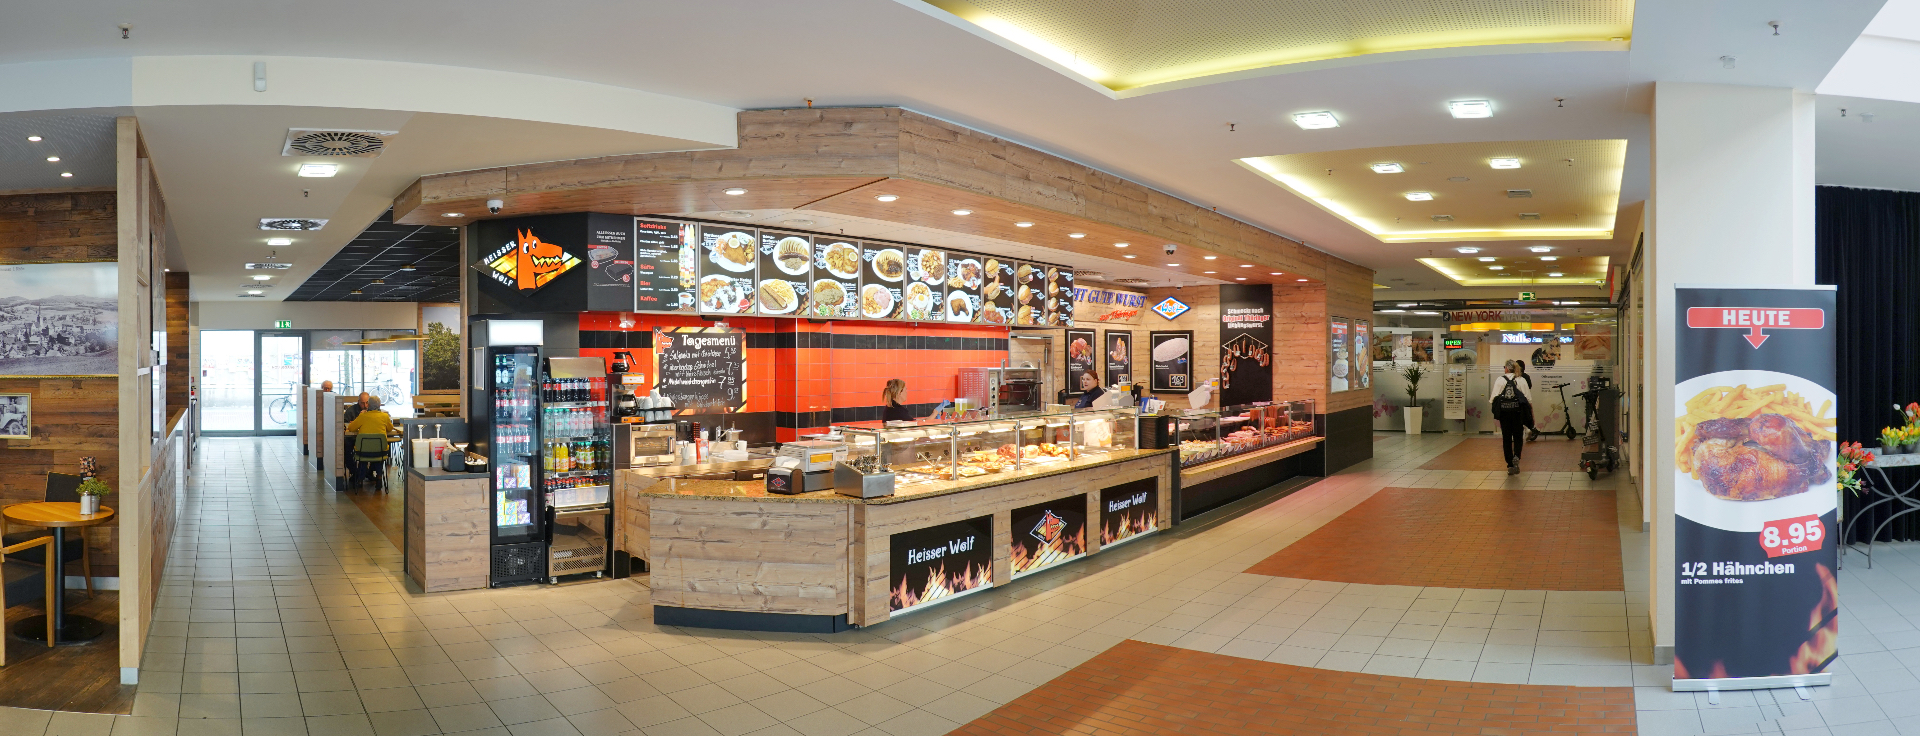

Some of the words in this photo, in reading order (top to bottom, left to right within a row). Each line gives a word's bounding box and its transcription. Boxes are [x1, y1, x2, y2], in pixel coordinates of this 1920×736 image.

[484, 240, 516, 265] HEISSER
[492, 271, 514, 286] WOLF
[1074, 288, 1088, 301] HT
[1088, 290, 1115, 304] GUTE
[1116, 293, 1147, 308] WURST
[1162, 303, 1183, 313] Wolf
[1244, 314, 1270, 322] Thüringer
[1451, 311, 1473, 321] NEW
[1476, 311, 1502, 321] YORK
[1504, 311, 1531, 321] NAILS
[1722, 310, 1790, 326] HEUTE
[682, 334, 736, 350] Tagesmenü
[1502, 332, 1531, 343] Nails
[1109, 499, 1131, 513] Heisser
[1132, 492, 1148, 504] Wolf
[1763, 520, 1822, 548] 8.95
[907, 545, 947, 566] Heisser
[949, 536, 975, 555] Wolf
[1781, 545, 1807, 555] Portion
[1681, 562, 1707, 576] 1/2
[1713, 561, 1794, 576] Hähnchen
